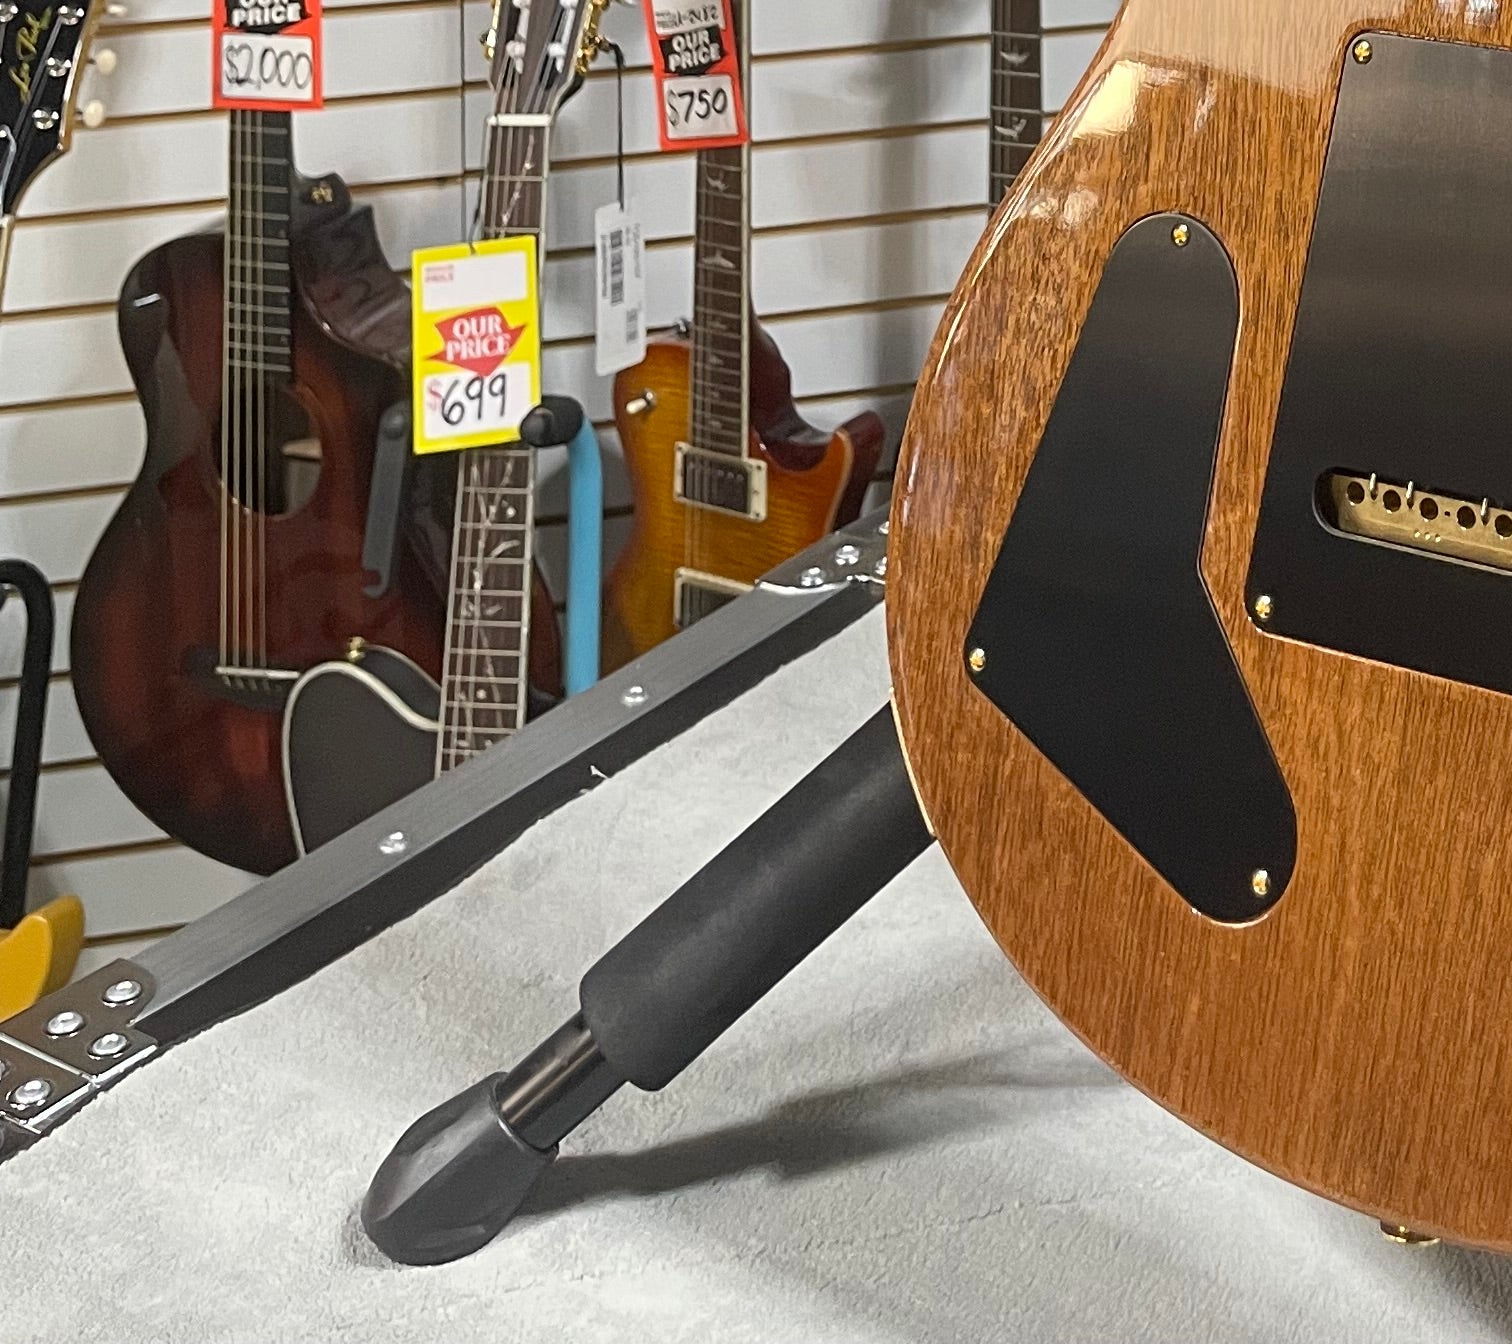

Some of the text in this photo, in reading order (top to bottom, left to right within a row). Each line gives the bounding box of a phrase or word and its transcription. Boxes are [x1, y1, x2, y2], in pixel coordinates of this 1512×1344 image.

[232, 3, 302, 28] PRICE
[671, 29, 711, 53] OUR
[225, 42, 313, 91] $2,000
[668, 43, 721, 73] PRICE
[667, 87, 728, 126] $750
[452, 313, 503, 339] OUR
[446, 332, 511, 362] PRICE
[426, 372, 508, 427] $699
